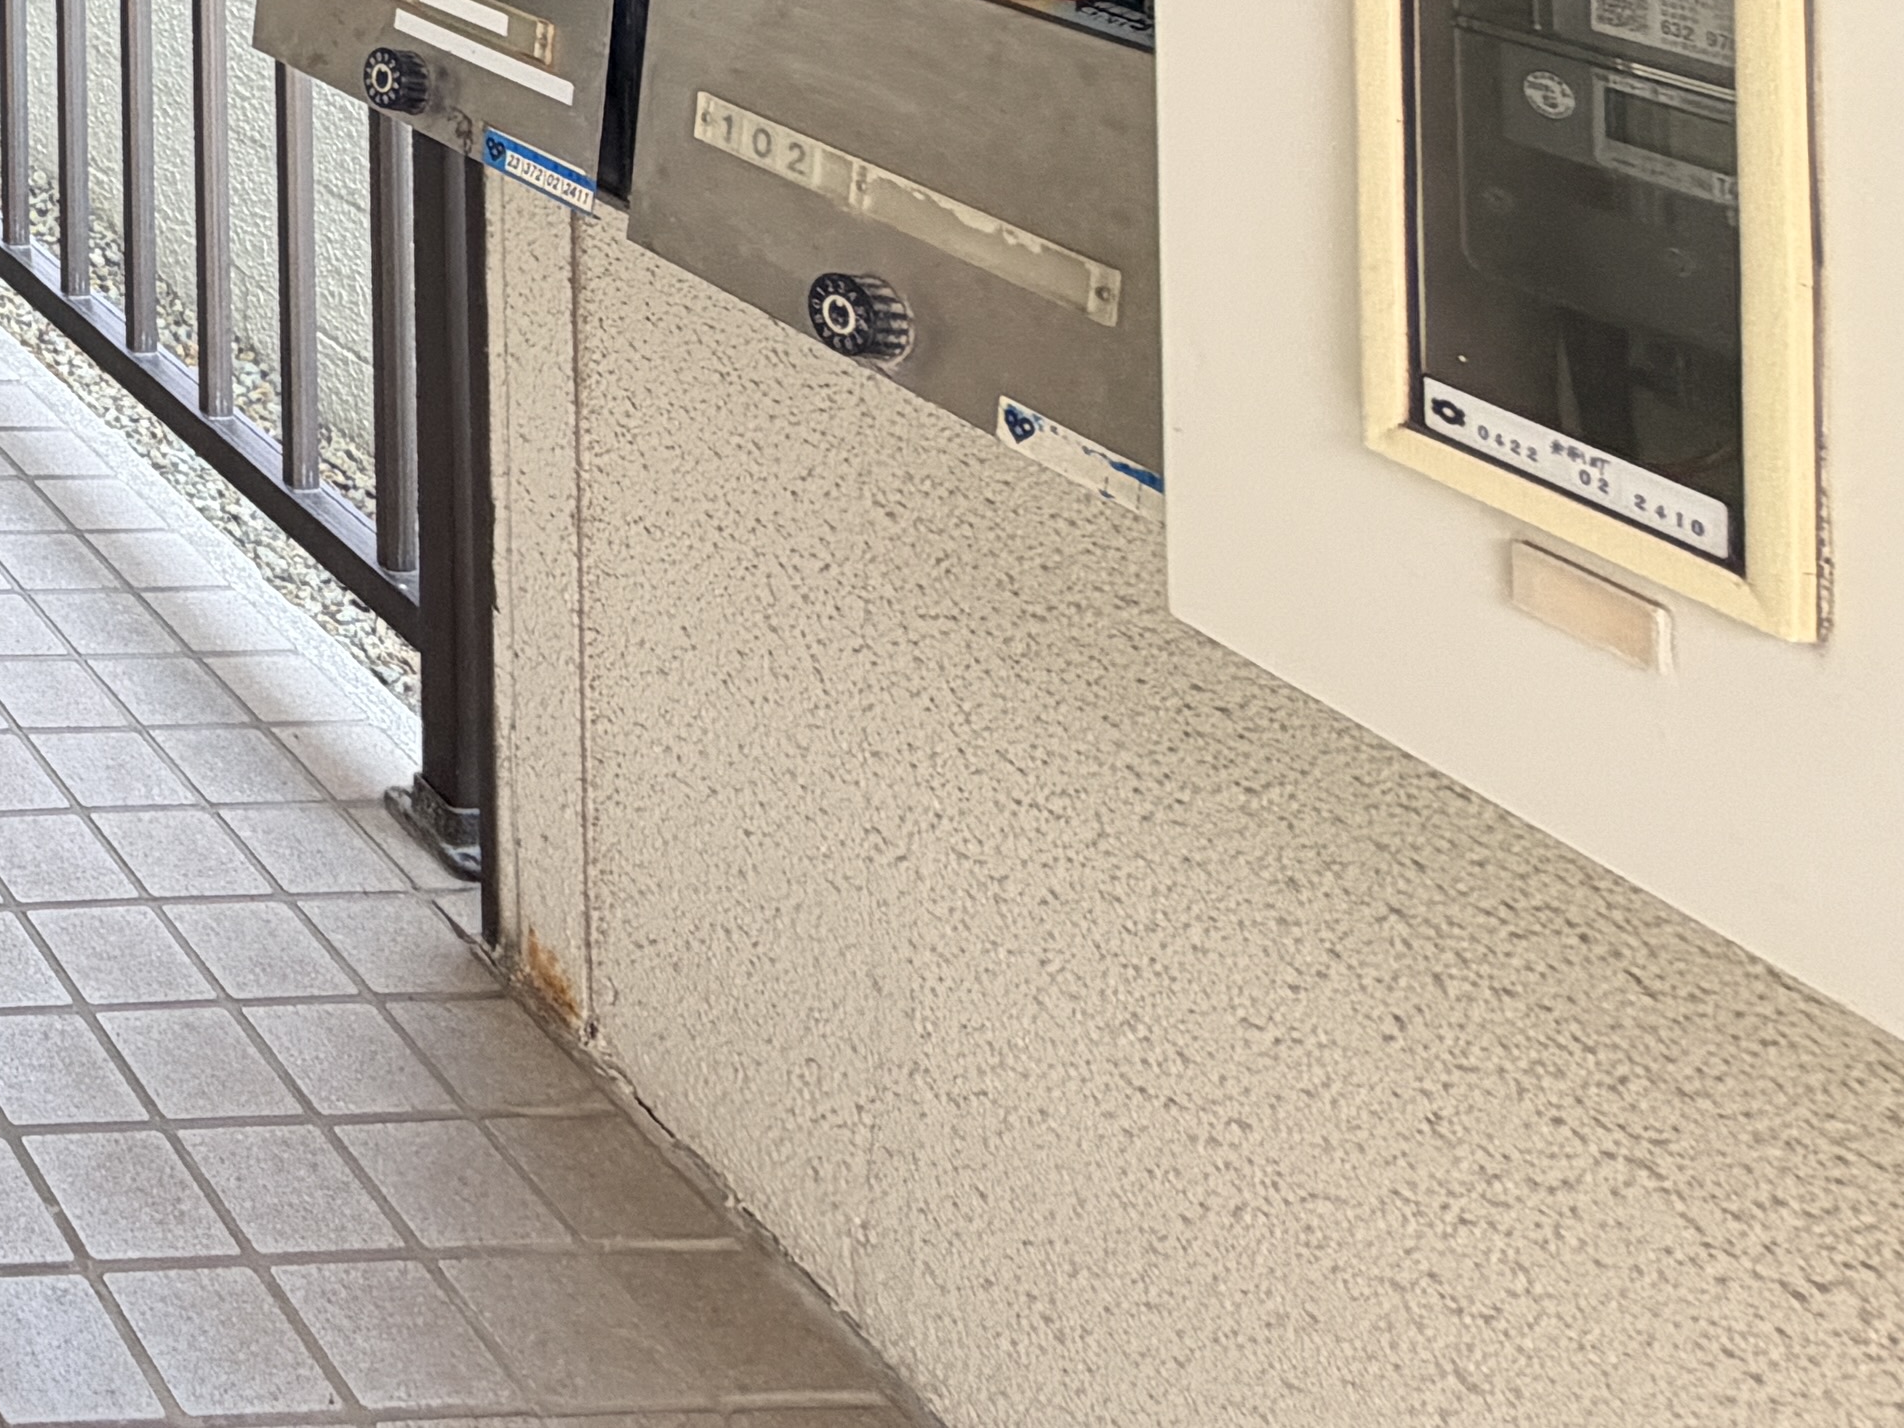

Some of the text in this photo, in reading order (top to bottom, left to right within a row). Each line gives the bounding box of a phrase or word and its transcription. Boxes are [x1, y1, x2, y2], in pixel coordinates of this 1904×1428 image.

[1660, 19, 1695, 42] 632
[721, 114, 807, 176] 102
[507, 154, 521, 170] 23
[523, 162, 543, 182] 372
[547, 174, 560, 190] 02
[1579, 469, 1610, 494] 02
